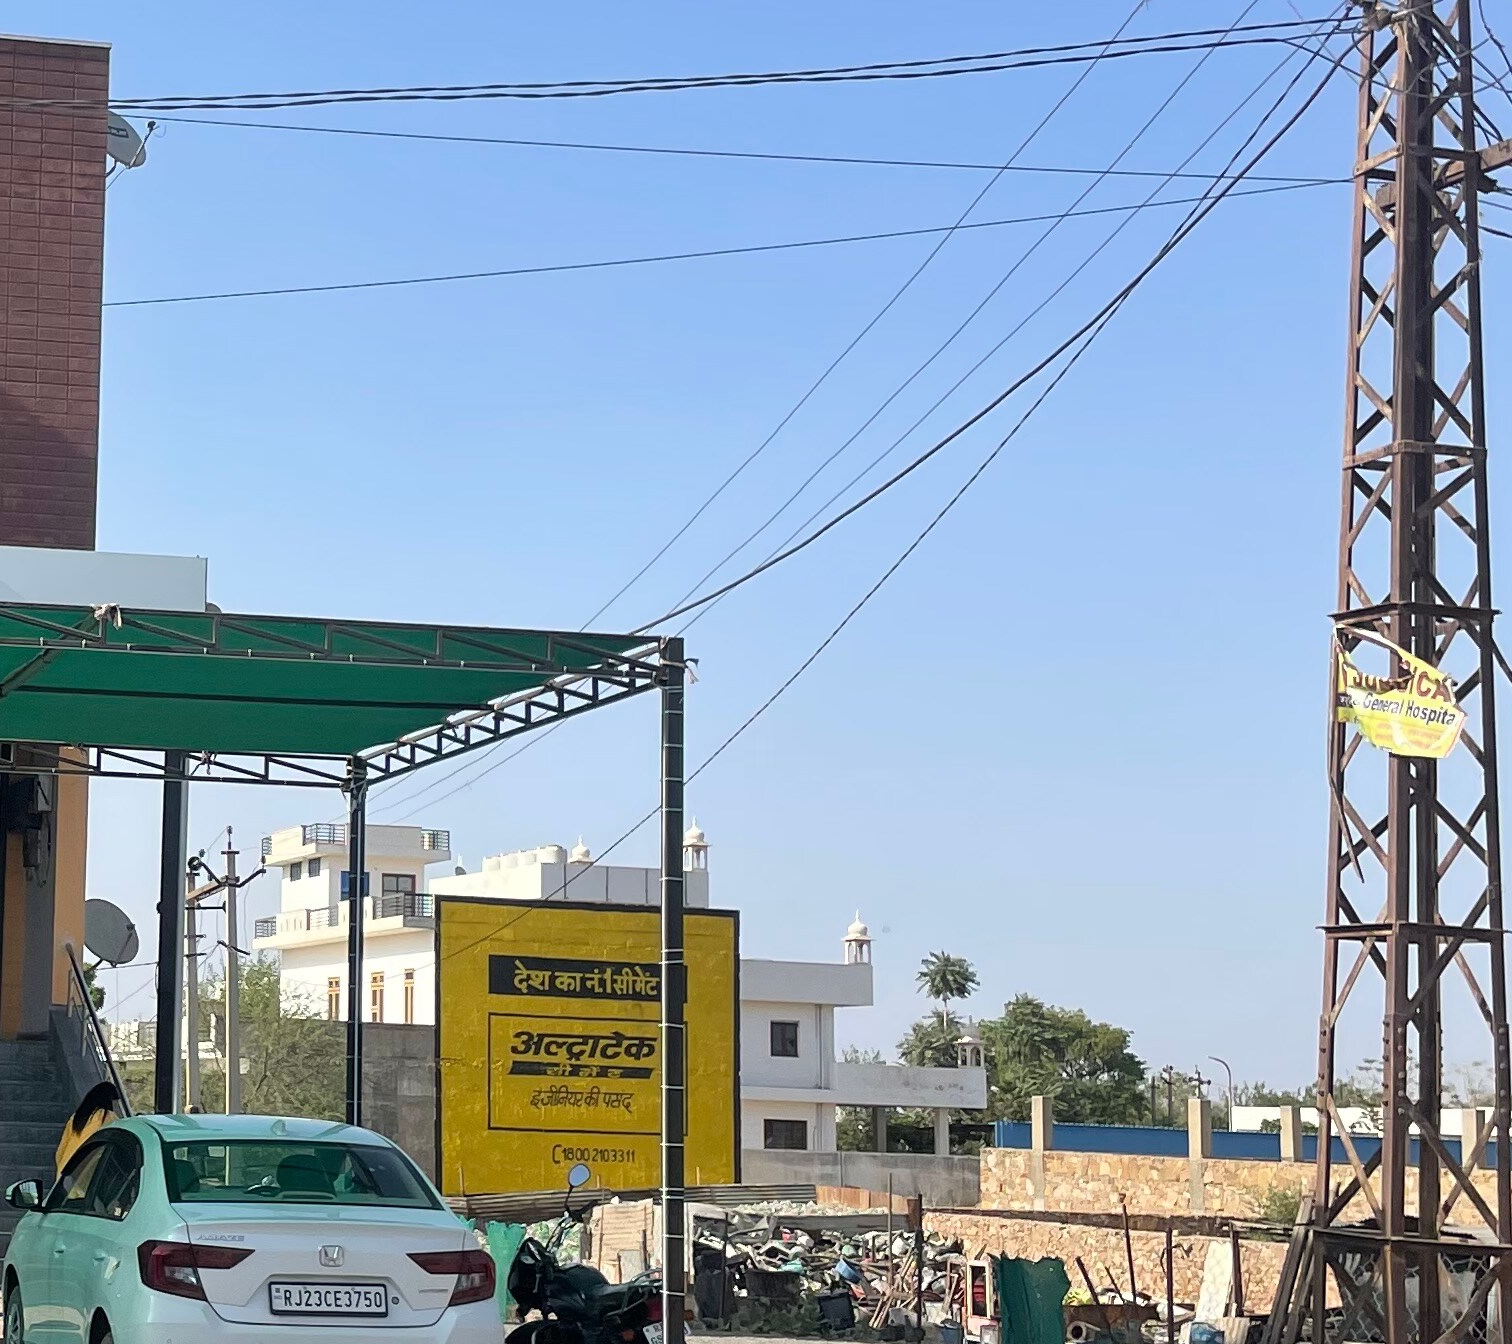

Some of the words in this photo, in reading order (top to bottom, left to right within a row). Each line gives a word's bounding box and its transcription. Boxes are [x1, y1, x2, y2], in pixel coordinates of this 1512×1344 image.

[1405, 700, 1456, 726] Hospita
[513, 959, 552, 994] देश
[554, 970, 584, 993] का
[510, 1030, 658, 1062] अल्ट्राटेक
[585, 1085, 601, 1108] की
[283, 1288, 383, 1309] RJ23CE3750
